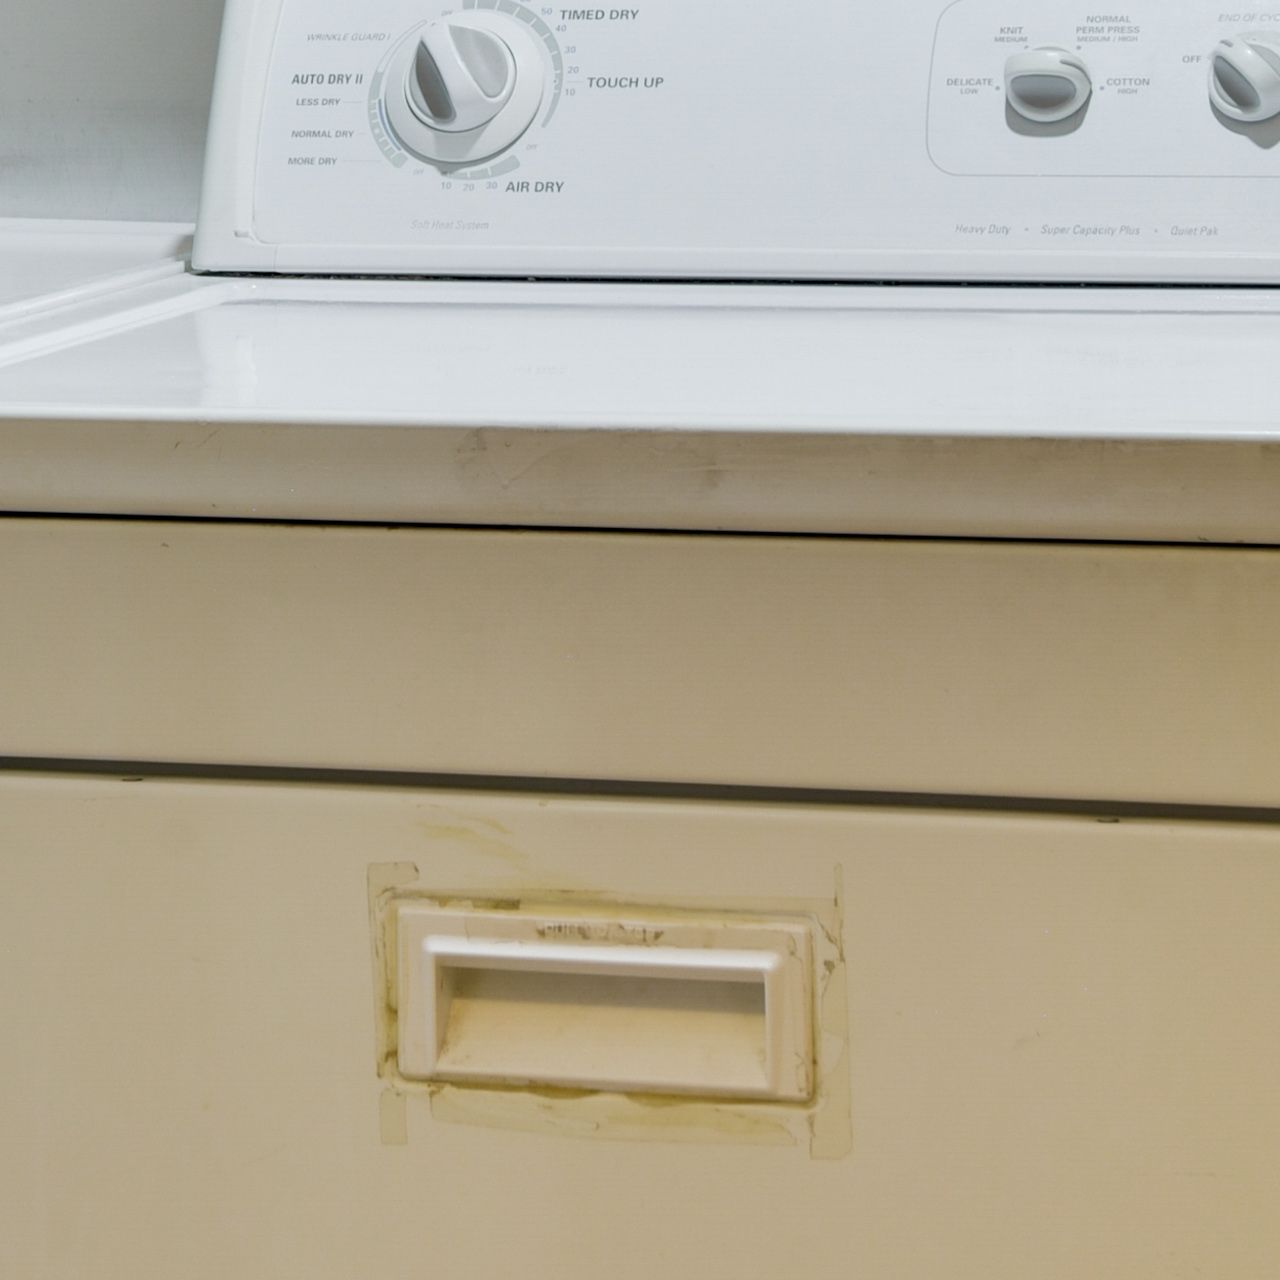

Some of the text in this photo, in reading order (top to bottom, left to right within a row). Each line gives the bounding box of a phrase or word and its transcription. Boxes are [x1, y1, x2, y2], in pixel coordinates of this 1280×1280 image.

[541, 7, 553, 15] 50
[560, 9, 640, 21] TIMED DRY
[1086, 15, 1131, 24] NORMAL
[555, 24, 567, 32] 40
[999, 26, 1024, 35] KNIT
[1075, 26, 1140, 34] PERM PRESS
[307, 33, 386, 42] WRINKLE GUARD
[564, 46, 577, 54] 30
[1182, 55, 1202, 64] OFF
[568, 66, 579, 74] 20
[291, 73, 325, 85] AUTO
[327, 73, 352, 85] DRY
[587, 77, 664, 88] TOUCH UP
[946, 78, 994, 87] DELICATE
[1106, 78, 1150, 86] COTTON
[296, 98, 341, 106] LESS DRY
[291, 130, 354, 138] NORMAL DRY
[288, 157, 337, 165] MORE DRY
[441, 182, 452, 190] 10
[462, 183, 475, 191] 20
[486, 181, 498, 190] 30
[505, 181, 564, 192] AIR DRY
[955, 224, 1011, 235] Heavy Duty
[1041, 224, 1140, 236] Super Capacity Plus
[1170, 225, 1219, 236] Quiet Pak
